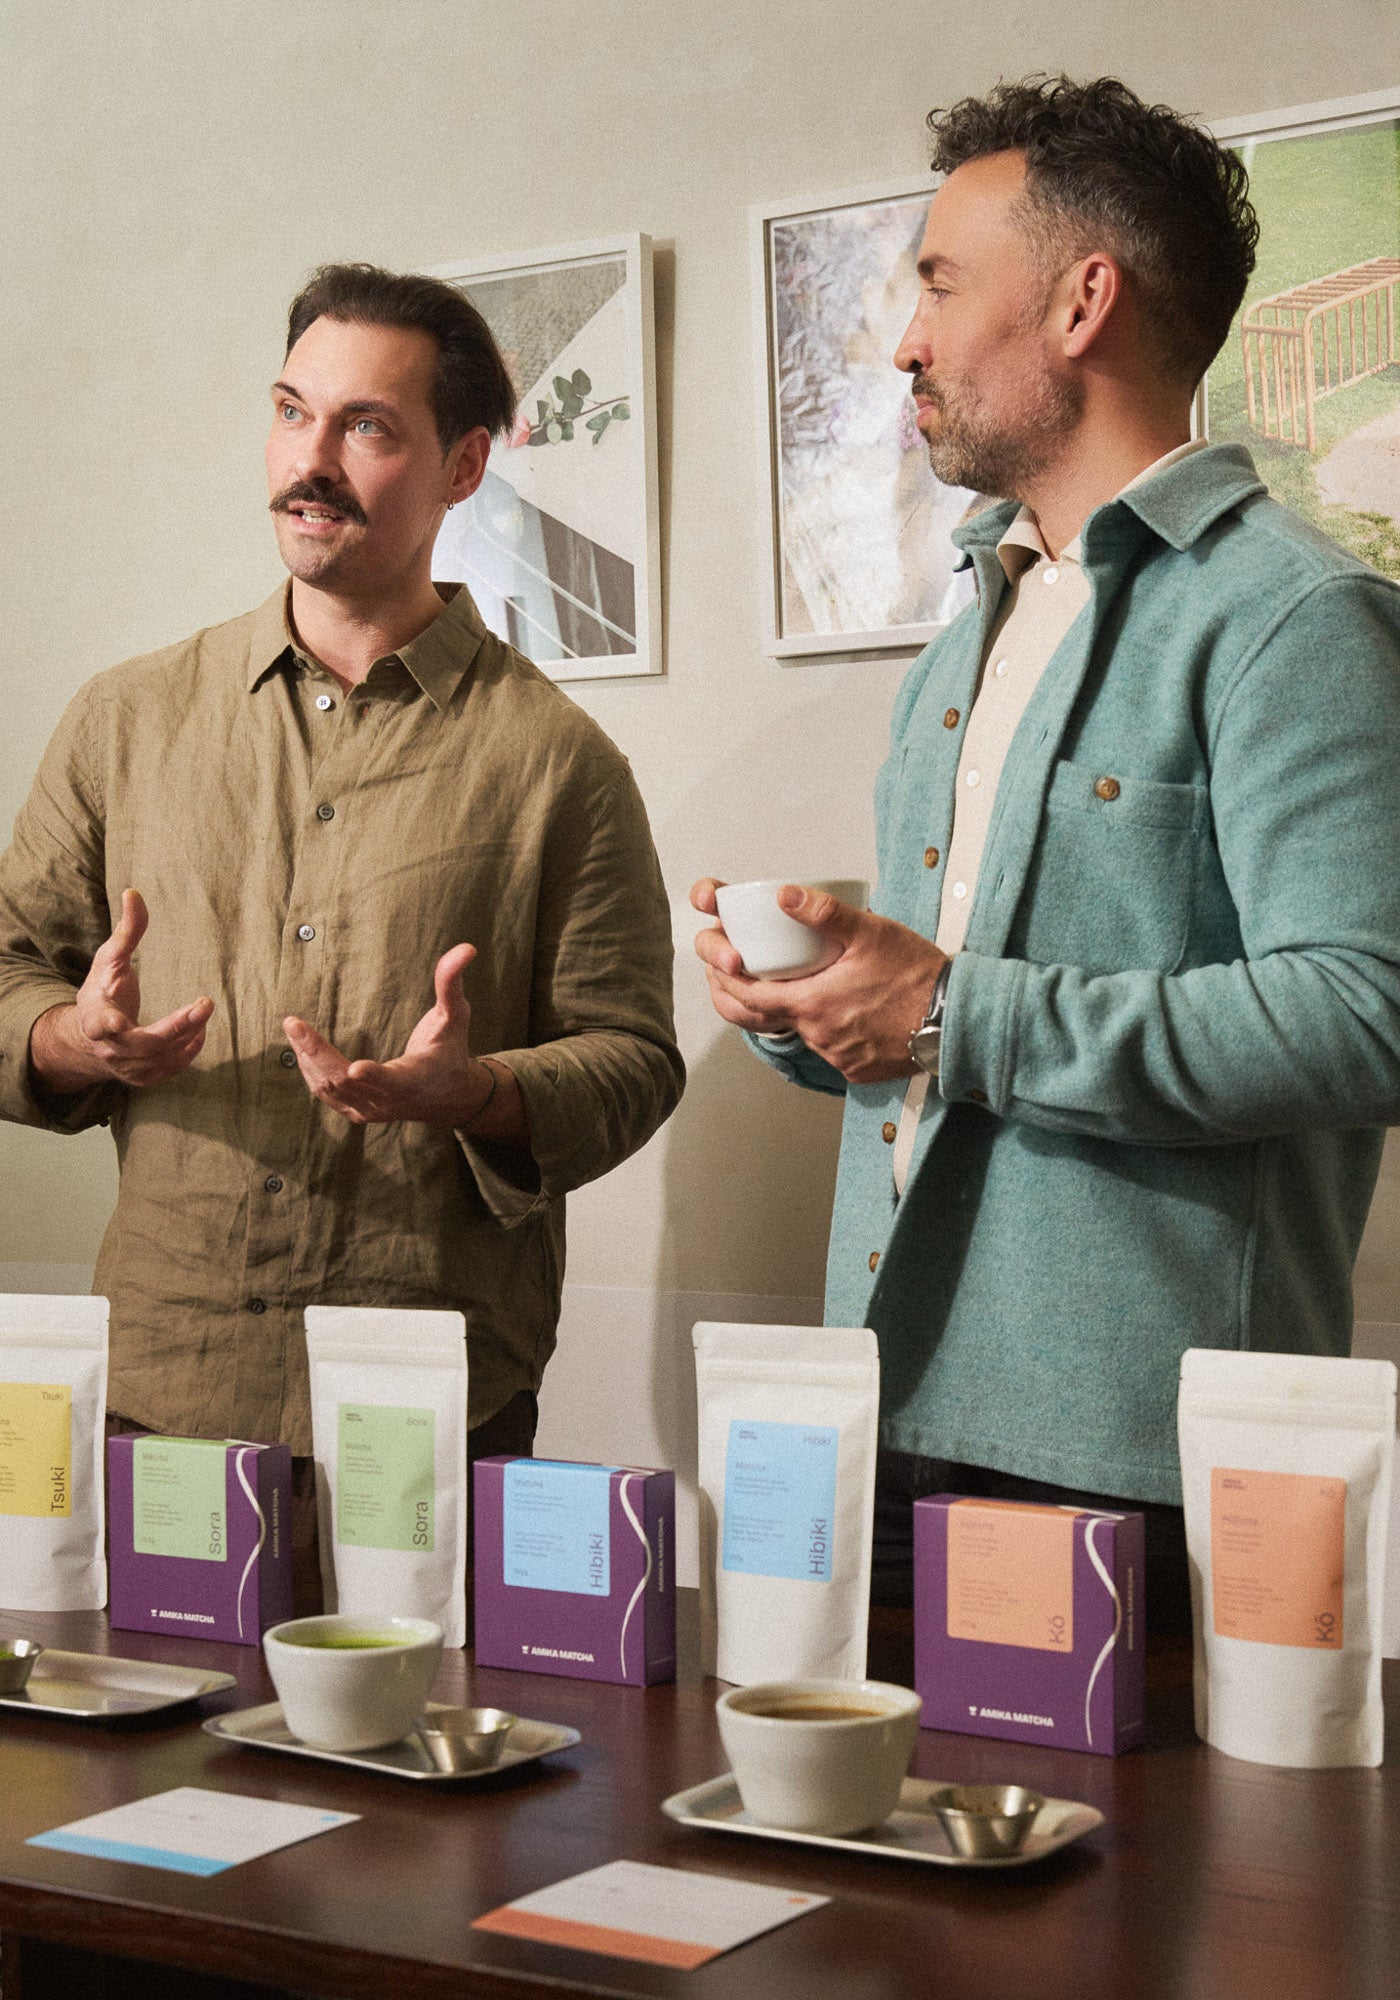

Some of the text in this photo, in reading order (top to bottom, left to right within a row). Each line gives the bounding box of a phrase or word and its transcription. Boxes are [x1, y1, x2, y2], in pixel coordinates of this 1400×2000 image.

[50, 1466, 65, 1512] Tsuki
[209, 1511, 222, 1555] Sora
[412, 1501, 428, 1546] Sora
[589, 1533, 604, 1589] Hibiki
[809, 1518, 827, 1575] Hibiki
[159, 1609, 215, 1624] AMIKA MATCHA
[531, 1646, 595, 1662] AMIKA MATCHA
[980, 1707, 1055, 1728] AMIKA MATCHA
